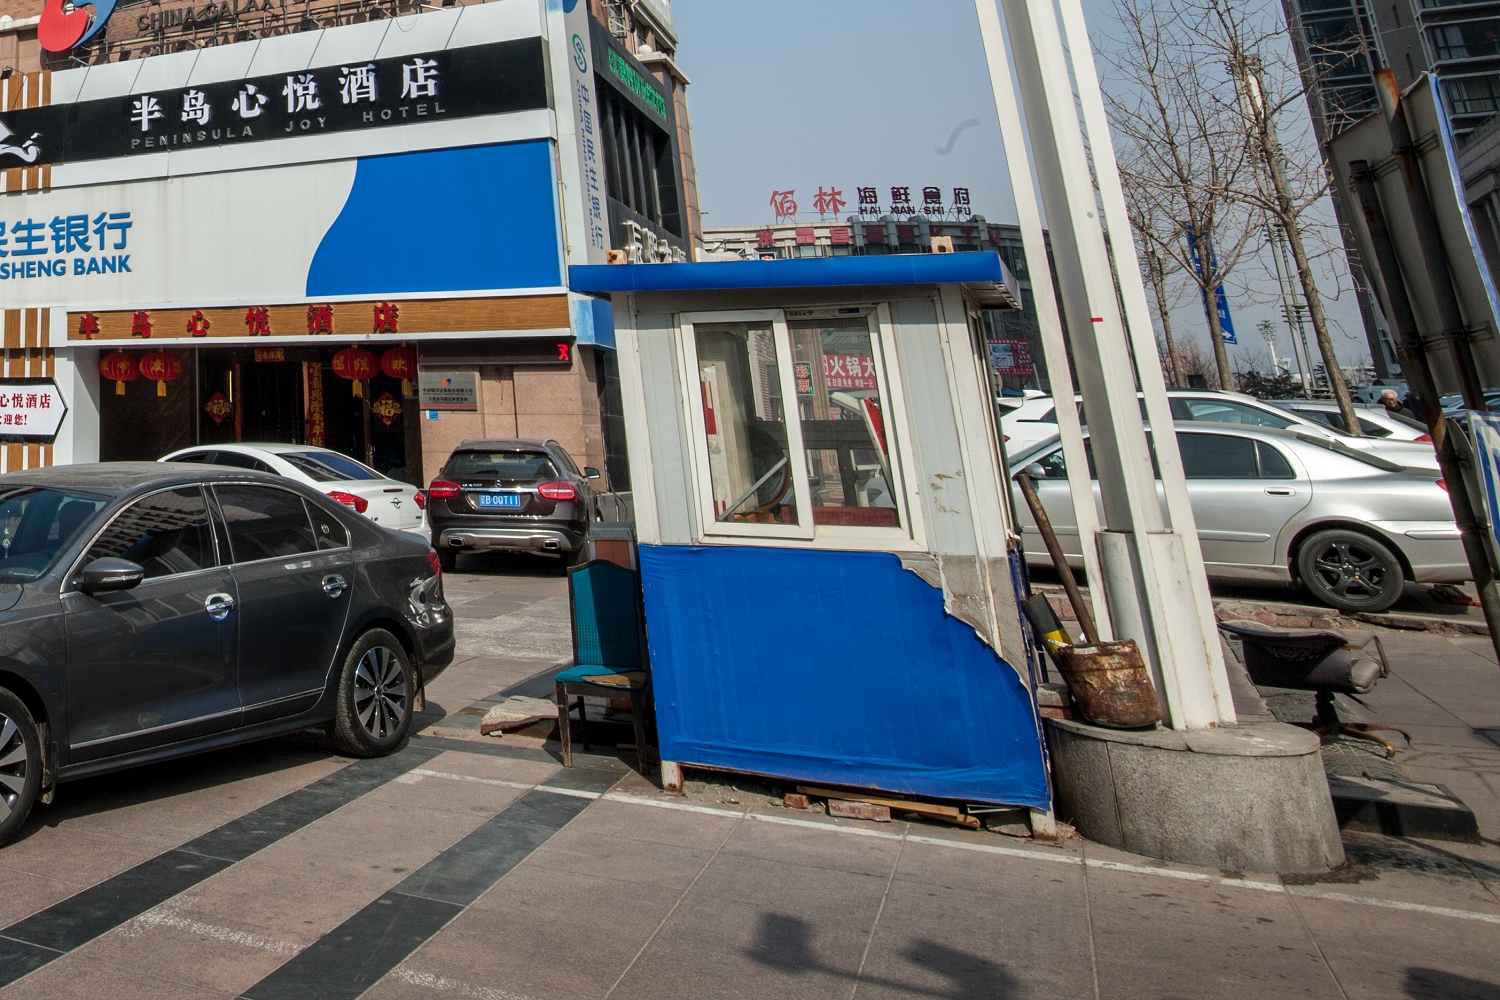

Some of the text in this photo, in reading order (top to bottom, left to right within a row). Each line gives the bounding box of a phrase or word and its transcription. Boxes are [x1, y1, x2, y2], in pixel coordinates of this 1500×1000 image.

[136, 4, 198, 31] CHINA
[130, 58, 442, 128] 半岛心悦酒店
[130, 100, 448, 149] PENINSULA JOY HOTEL
[581, 83, 604, 251] 中国民生银行
[769, 185, 848, 218] 佰林
[859, 206, 882, 215] HAI
[890, 206, 916, 215] XIAN
[923, 206, 946, 215] SHI
[74, 253, 133, 276] BANK
[78, 302, 401, 340] 半岛心悦酒店
[795, 364, 811, 393] 彩票
